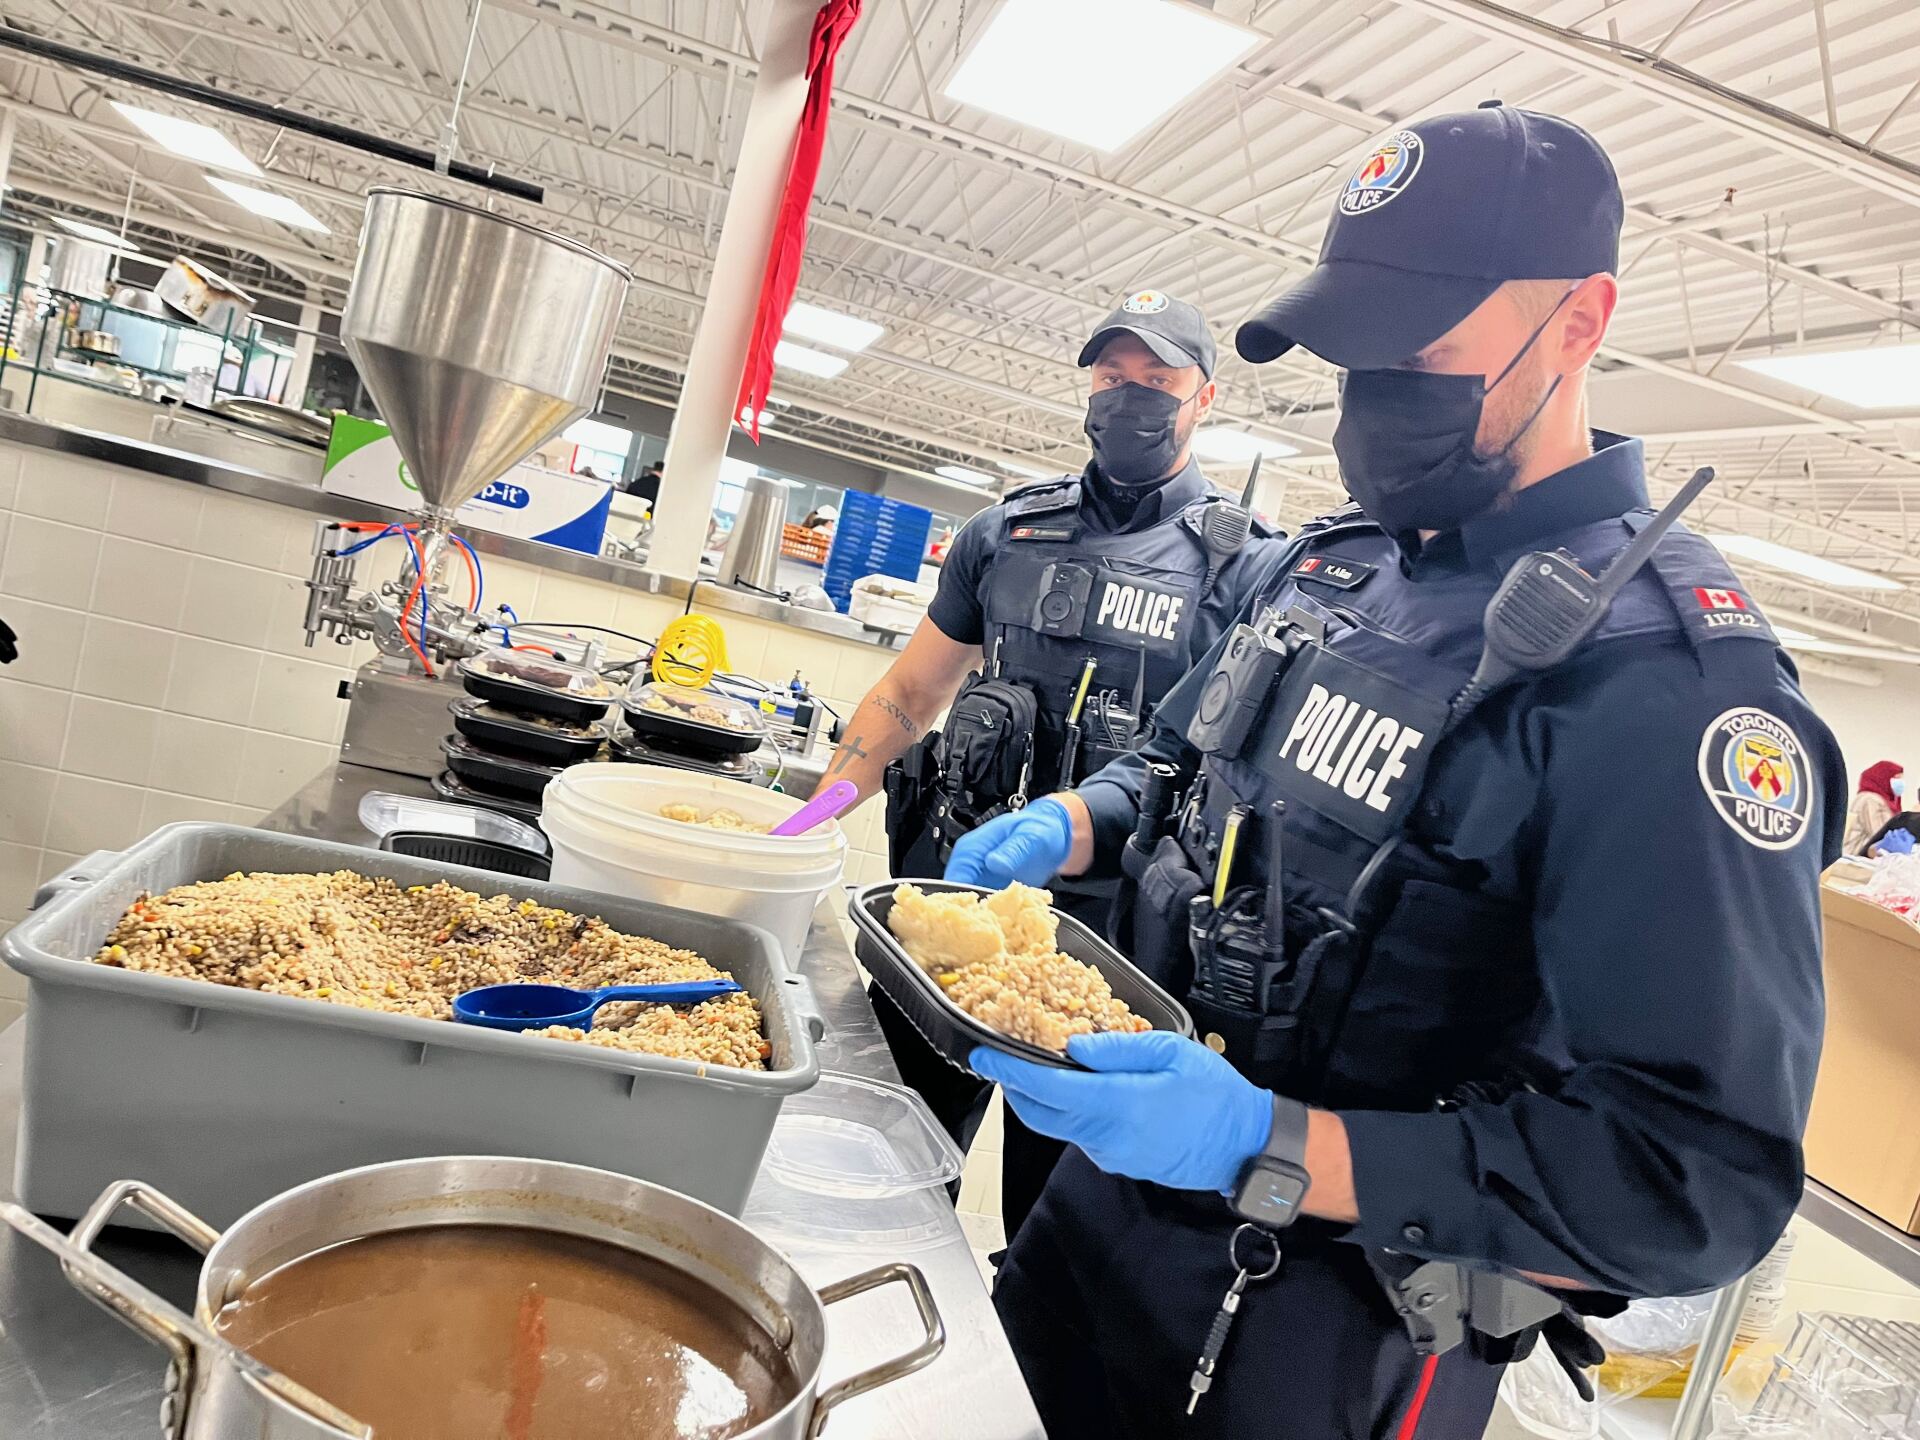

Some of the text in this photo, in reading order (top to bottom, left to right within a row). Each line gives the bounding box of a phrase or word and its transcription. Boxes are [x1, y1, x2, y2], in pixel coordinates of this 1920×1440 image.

[1342, 189, 1383, 211] POLICE
[481, 484, 518, 504] p-it
[1096, 581, 1183, 641] POLICE
[1703, 612, 1760, 628] 11722
[1278, 683, 1424, 812] POLICE
[1720, 714, 1797, 755] TORONTO
[1735, 799, 1792, 836] POLICE
